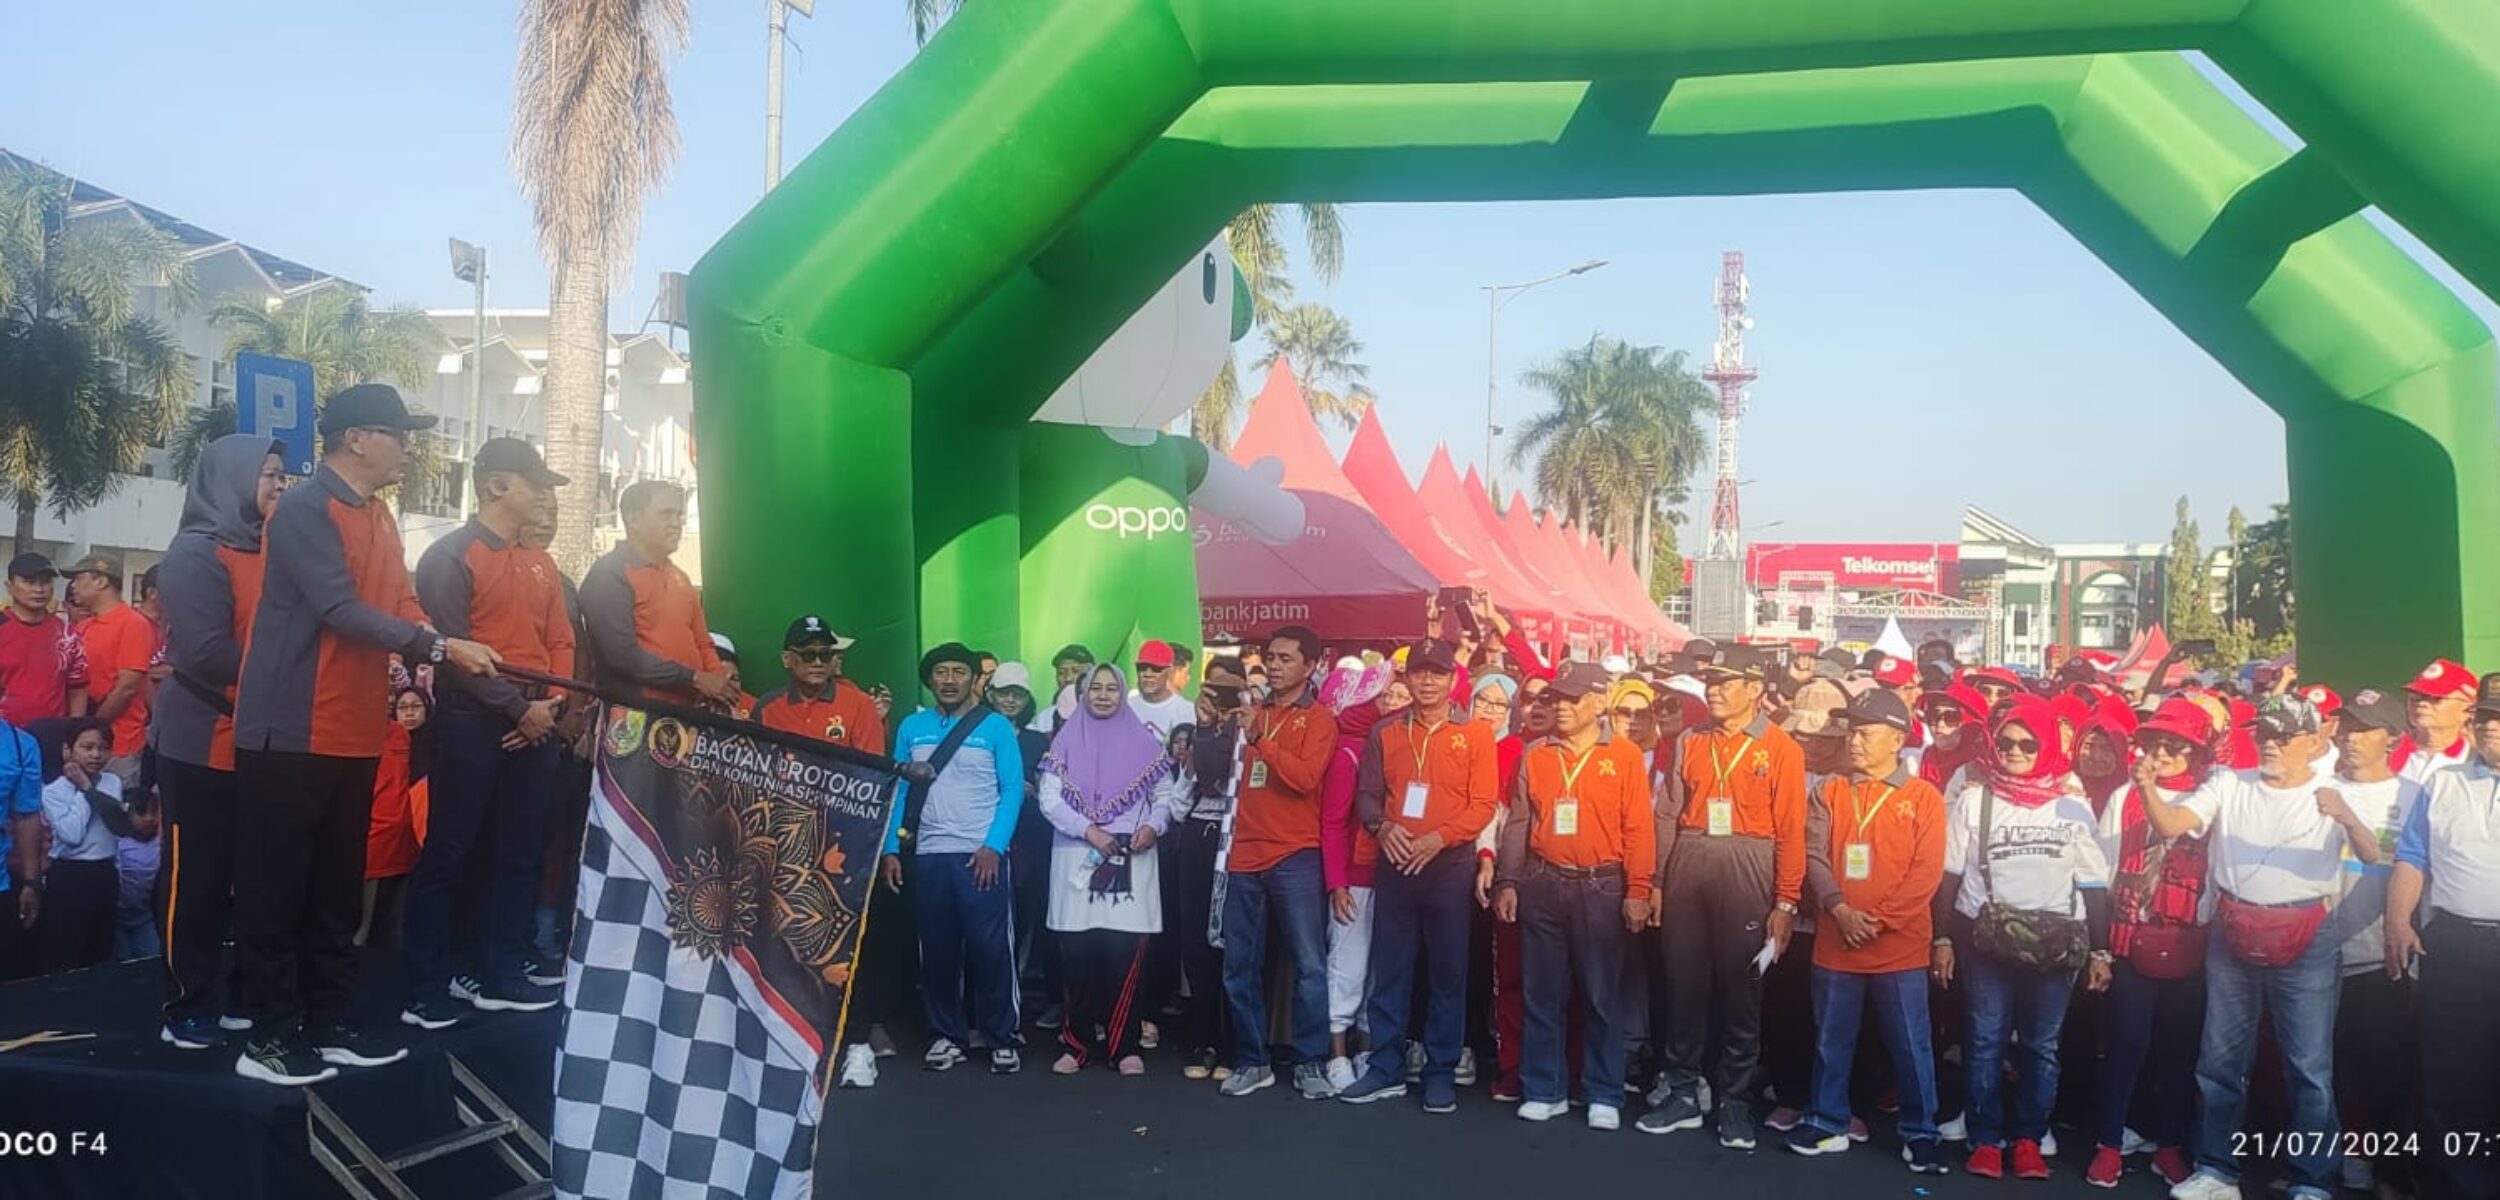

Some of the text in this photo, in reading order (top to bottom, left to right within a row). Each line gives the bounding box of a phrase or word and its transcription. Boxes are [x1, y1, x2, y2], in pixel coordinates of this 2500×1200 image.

[255, 373, 297, 437] P
[1085, 503, 1187, 541] oppo
[1841, 556, 1936, 575] Telkomsel
[1200, 600, 1310, 625] bankjatim
[690, 755, 721, 776] DAN
[695, 735, 772, 774] BAGIAN
[776, 754, 883, 804] PROTOKOL
